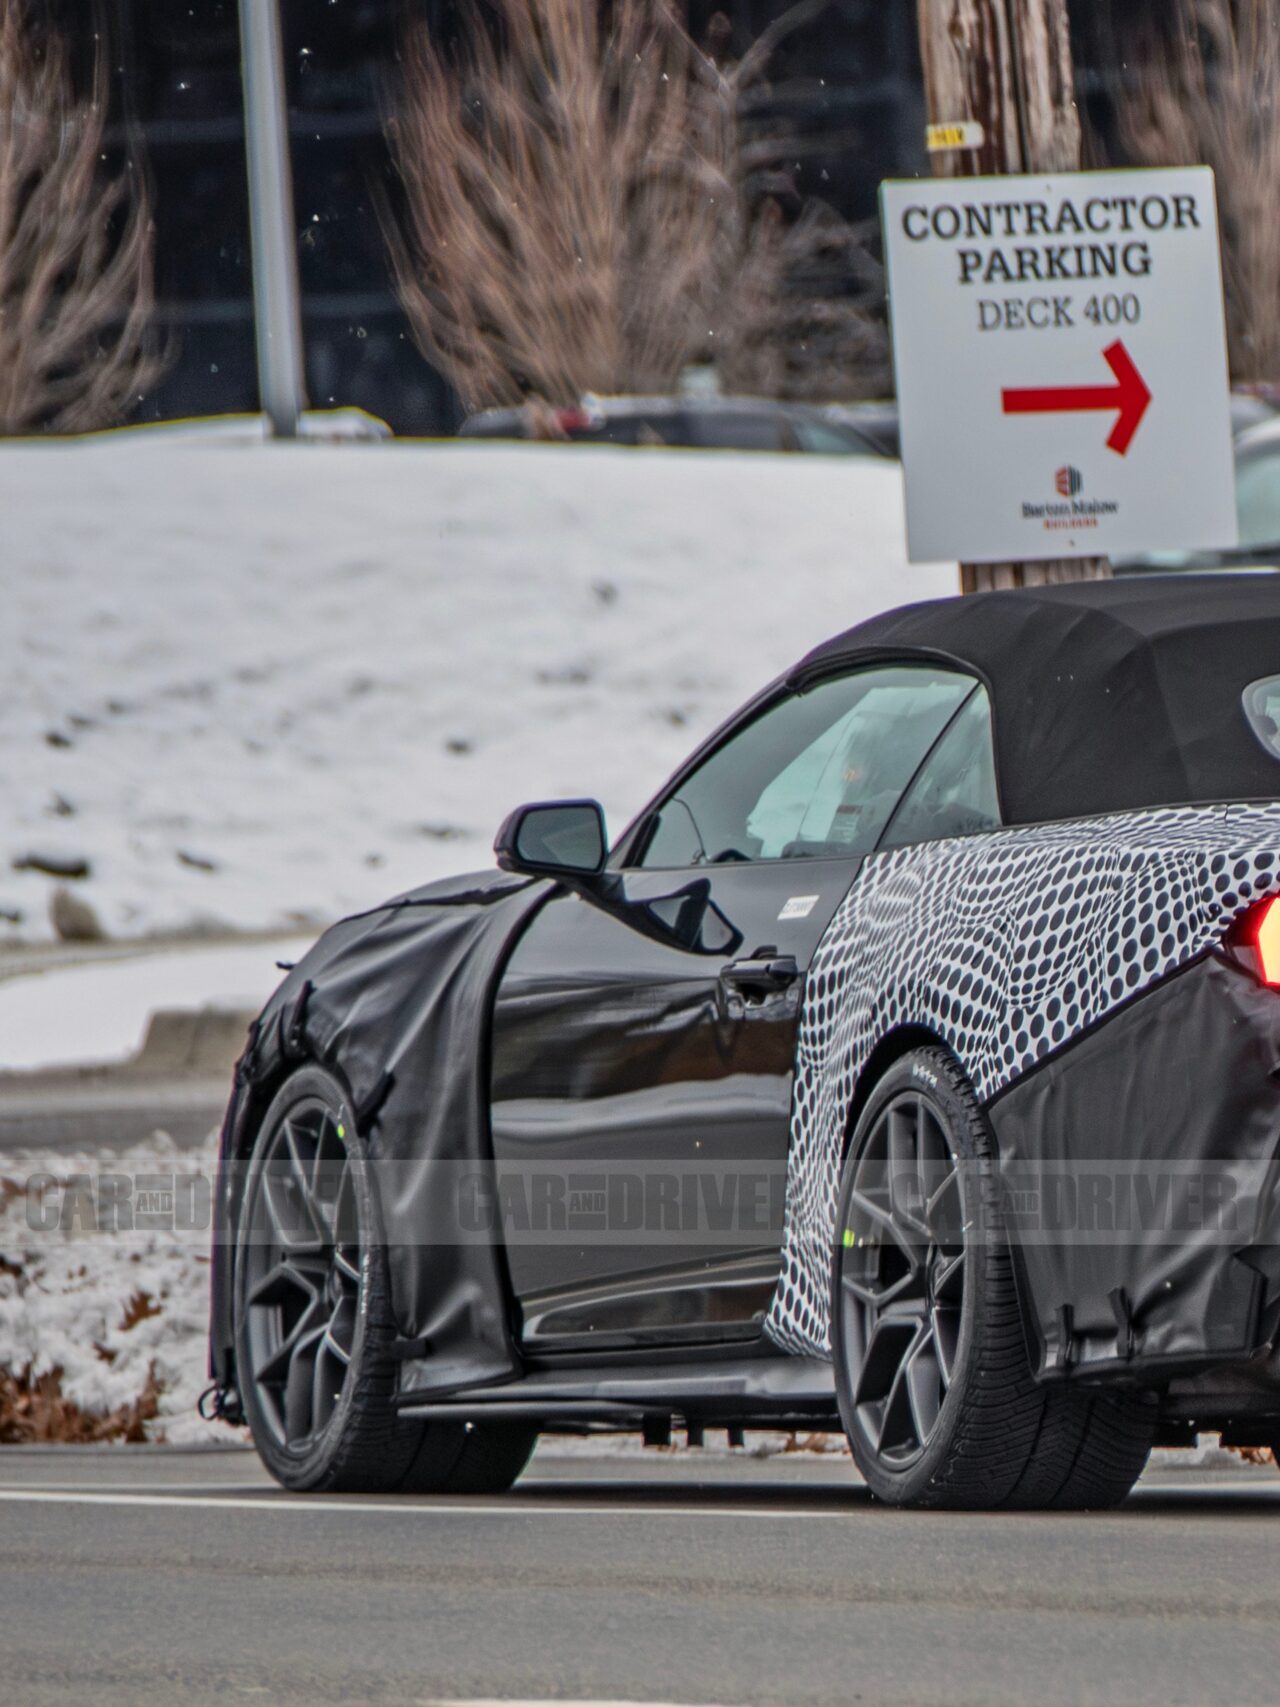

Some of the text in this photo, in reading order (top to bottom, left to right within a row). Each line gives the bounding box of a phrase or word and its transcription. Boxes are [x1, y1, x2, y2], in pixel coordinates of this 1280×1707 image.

[903, 195, 1201, 240] CONTRACTOR
[958, 242, 1152, 284] PARKING
[978, 293, 1140, 331] DECK 400
